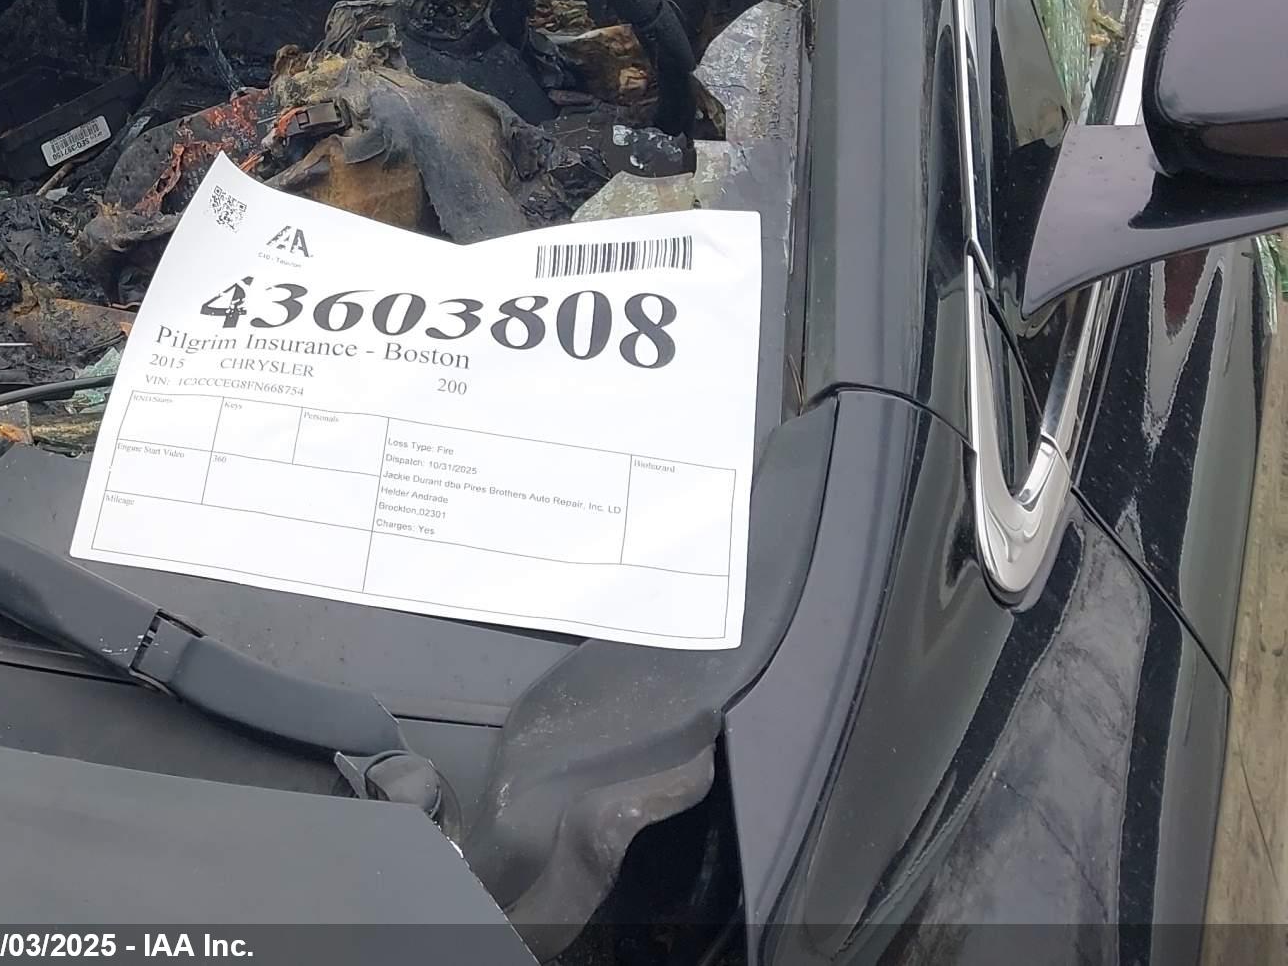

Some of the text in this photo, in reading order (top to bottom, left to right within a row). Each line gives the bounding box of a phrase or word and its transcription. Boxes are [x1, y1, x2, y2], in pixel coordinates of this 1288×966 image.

[200, 276, 678, 369] 43603808
[156, 325, 237, 353] Pilgrim
[245, 334, 358, 358] Insurance
[383, 342, 470, 370] Boston
[145, 375, 169, 386] VIN:
[149, 354, 468, 395] 2015 CHRYSLER 200
[224, 401, 243, 410] Keys
[303, 411, 339, 423] Personals
[117, 442, 185, 458] Engine Start Video
[388, 437, 454, 455] Loss Type: Fire
[213, 455, 227, 464] 360
[385, 453, 478, 475] Dispatch: 10/31/2025
[634, 458, 675, 473] Biohazard
[105, 494, 135, 506] Mileage
[381, 486, 448, 503] Helder Andrade
[383, 470, 410, 482] Jackie
[413, 475, 442, 487] Durant
[444, 480, 461, 490] dba
[464, 483, 486, 493] Pires
[489, 487, 527, 500] Brothers
[529, 493, 550, 504] Auto
[553, 496, 585, 510] Repair,
[608, 505, 621, 515] LD
[376, 518, 435, 535] Charges: Yes
